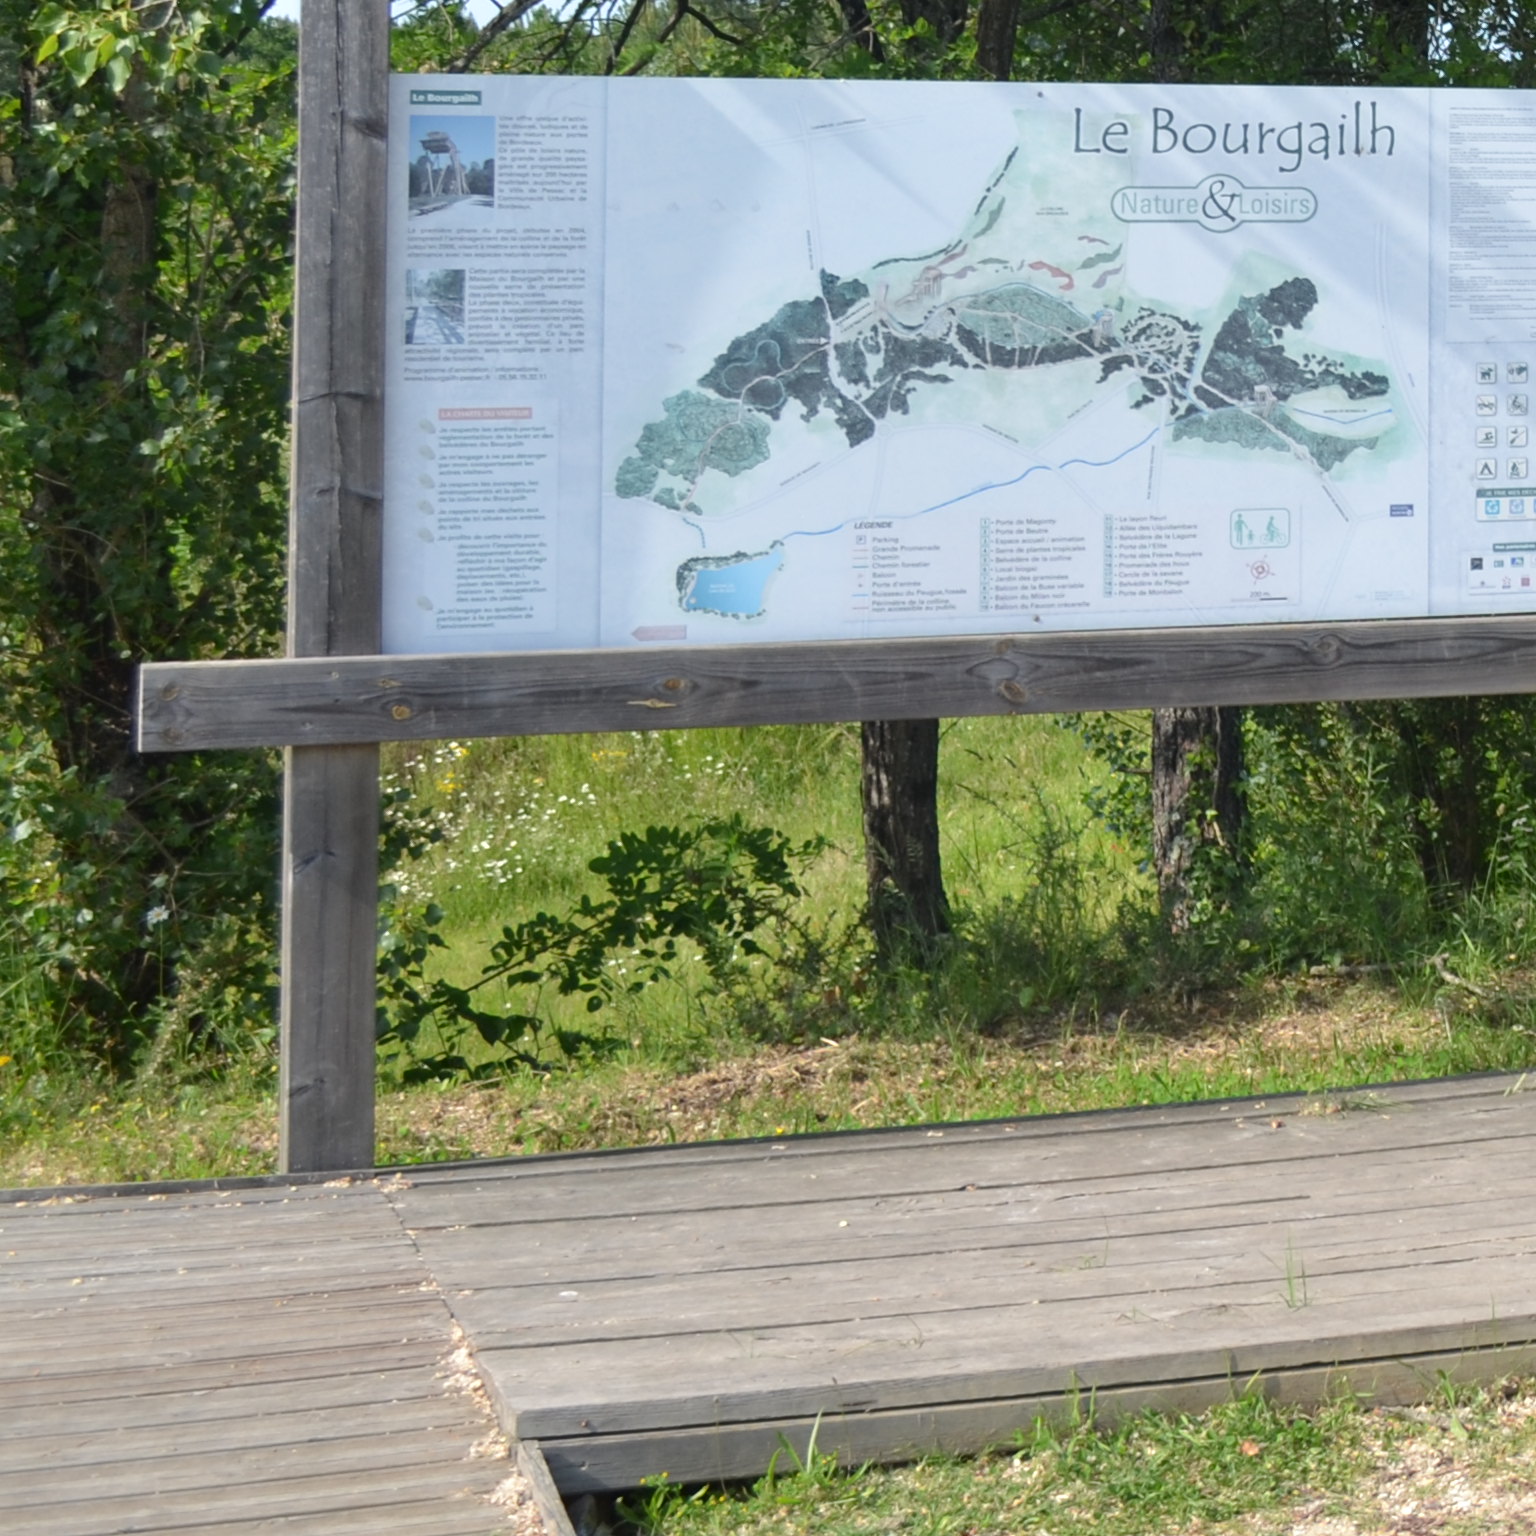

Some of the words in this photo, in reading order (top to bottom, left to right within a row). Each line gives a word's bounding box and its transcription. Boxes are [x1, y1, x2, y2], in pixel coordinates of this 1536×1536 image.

[412, 93, 425, 102] Le
[427, 93, 479, 104] Bourgailh
[1074, 107, 1129, 153] Le
[1152, 101, 1396, 173] Bourgailh
[1120, 192, 1199, 214] Nature
[1202, 180, 1241, 222] &
[1239, 192, 1311, 214] Loisirs
